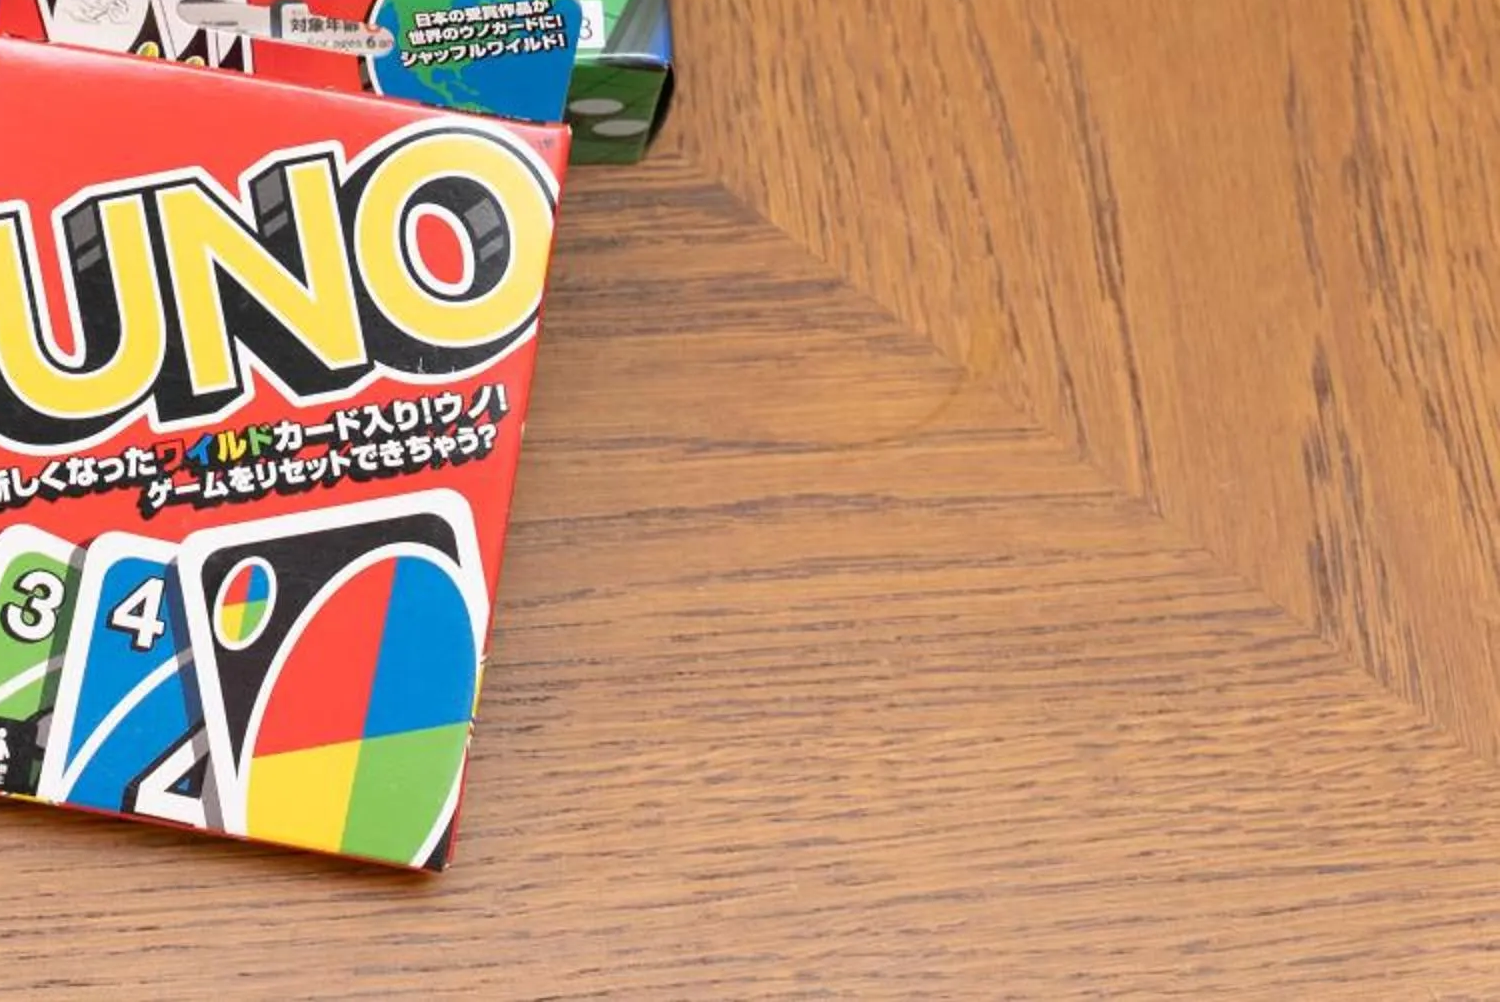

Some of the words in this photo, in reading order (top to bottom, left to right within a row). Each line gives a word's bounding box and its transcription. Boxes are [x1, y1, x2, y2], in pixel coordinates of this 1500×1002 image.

[147, 425, 497, 507] ゲームをリセットできちゃう?
[0, 568, 65, 643] 3
[106, 575, 166, 652] 4
